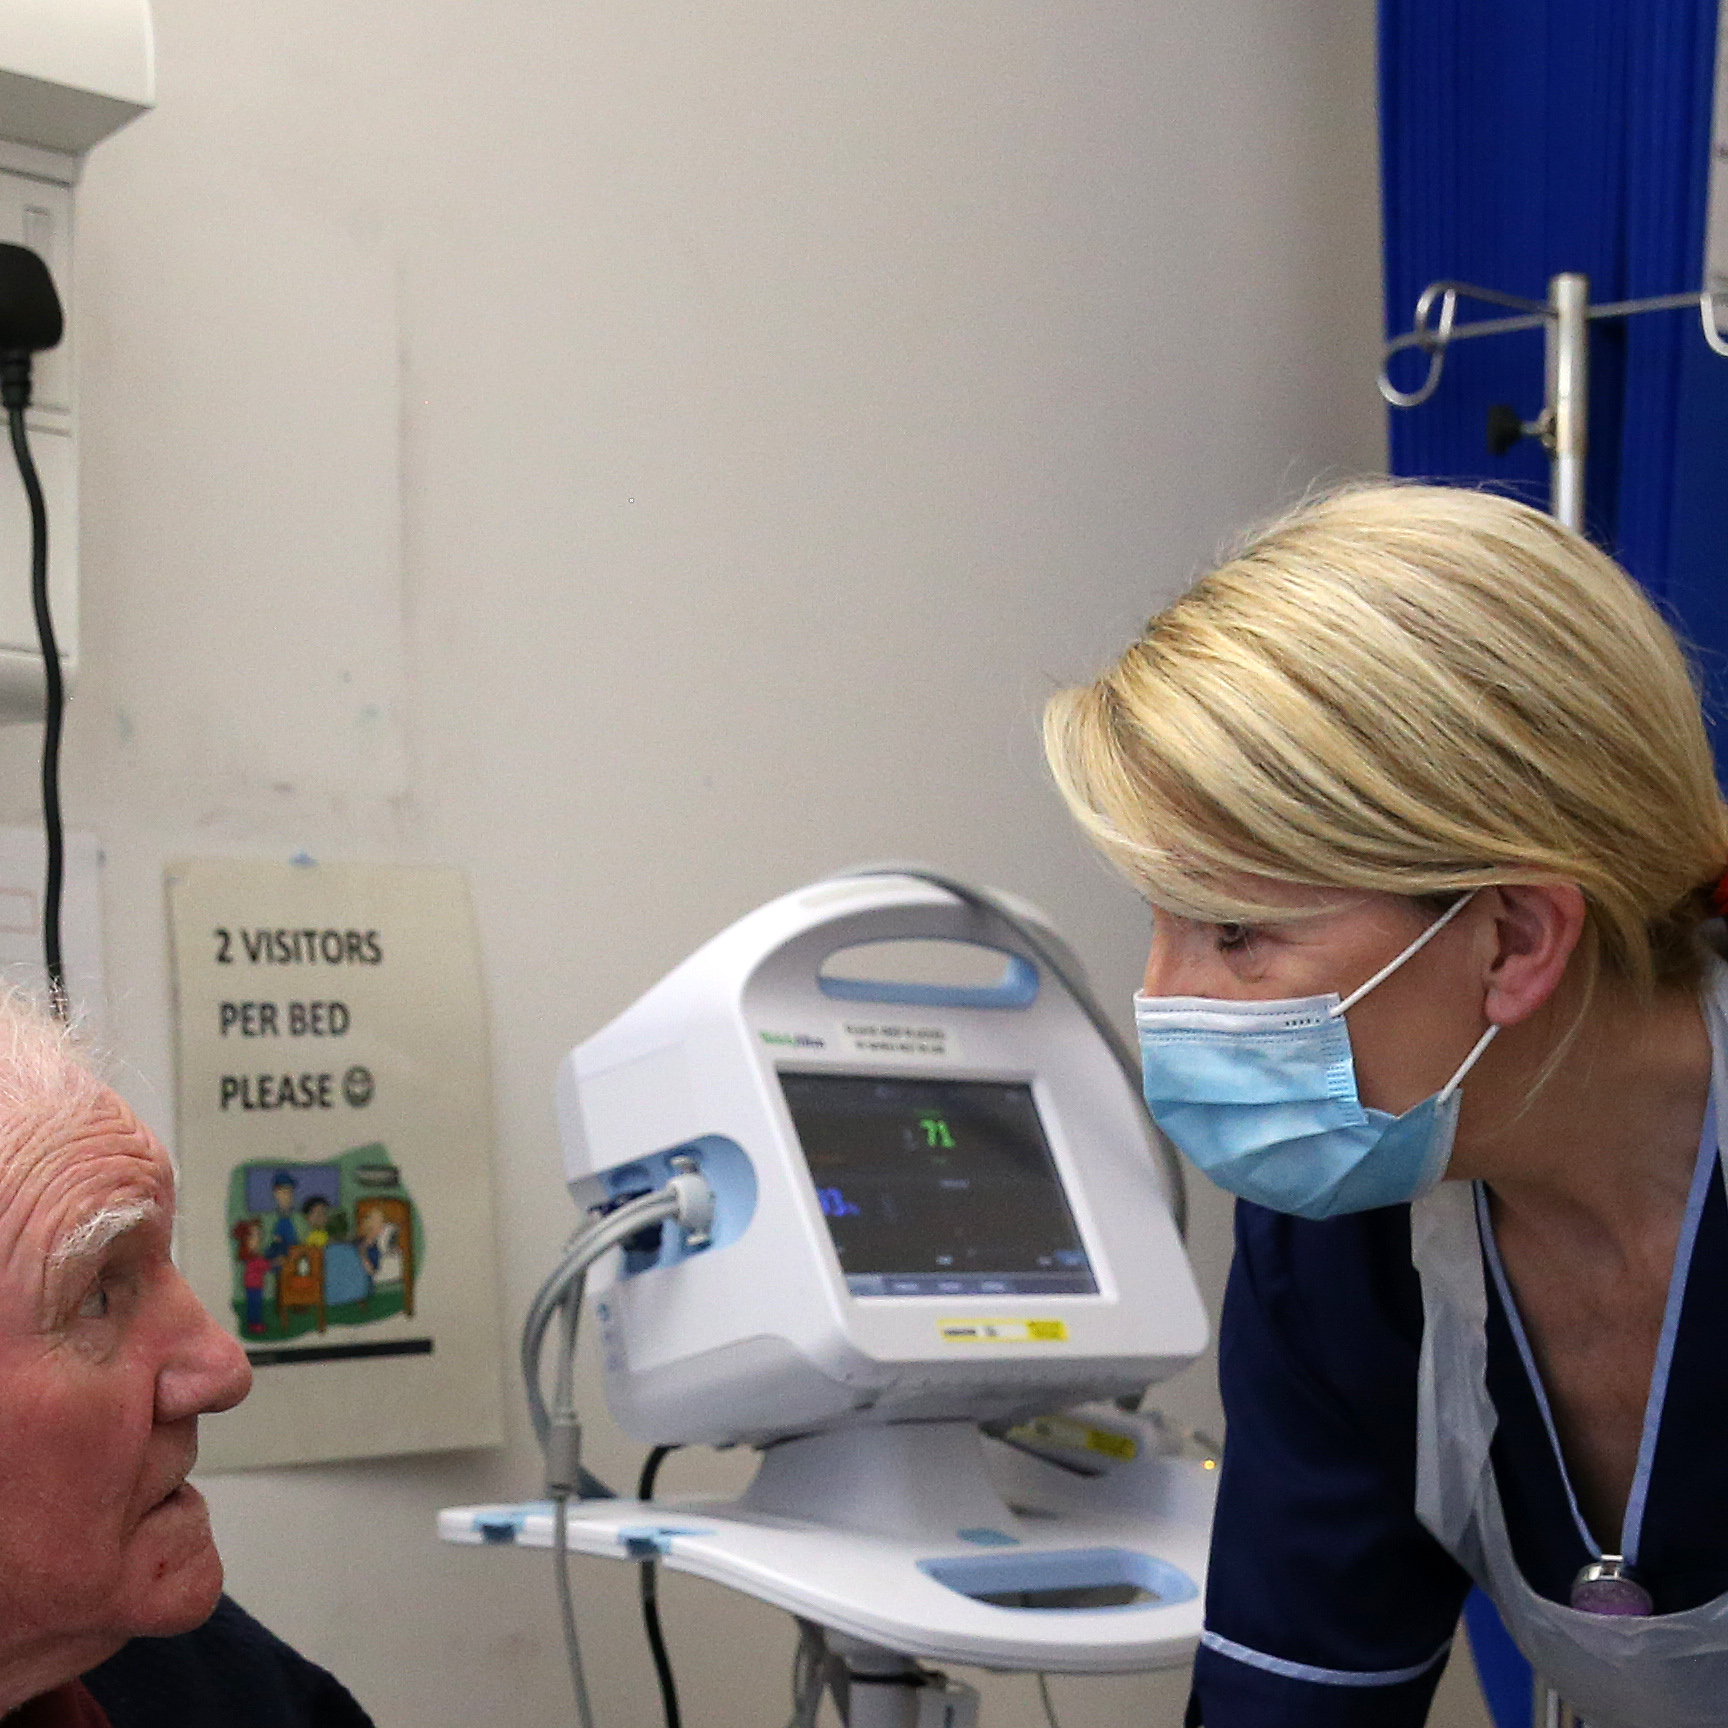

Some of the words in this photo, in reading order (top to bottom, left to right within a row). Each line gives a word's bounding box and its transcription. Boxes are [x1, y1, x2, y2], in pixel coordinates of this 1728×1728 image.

[215, 928, 234, 964] 2
[241, 928, 384, 966] VISITORS
[220, 1001, 280, 1038] PER
[288, 1001, 351, 1038] BED
[220, 1072, 332, 1110] PLEASE
